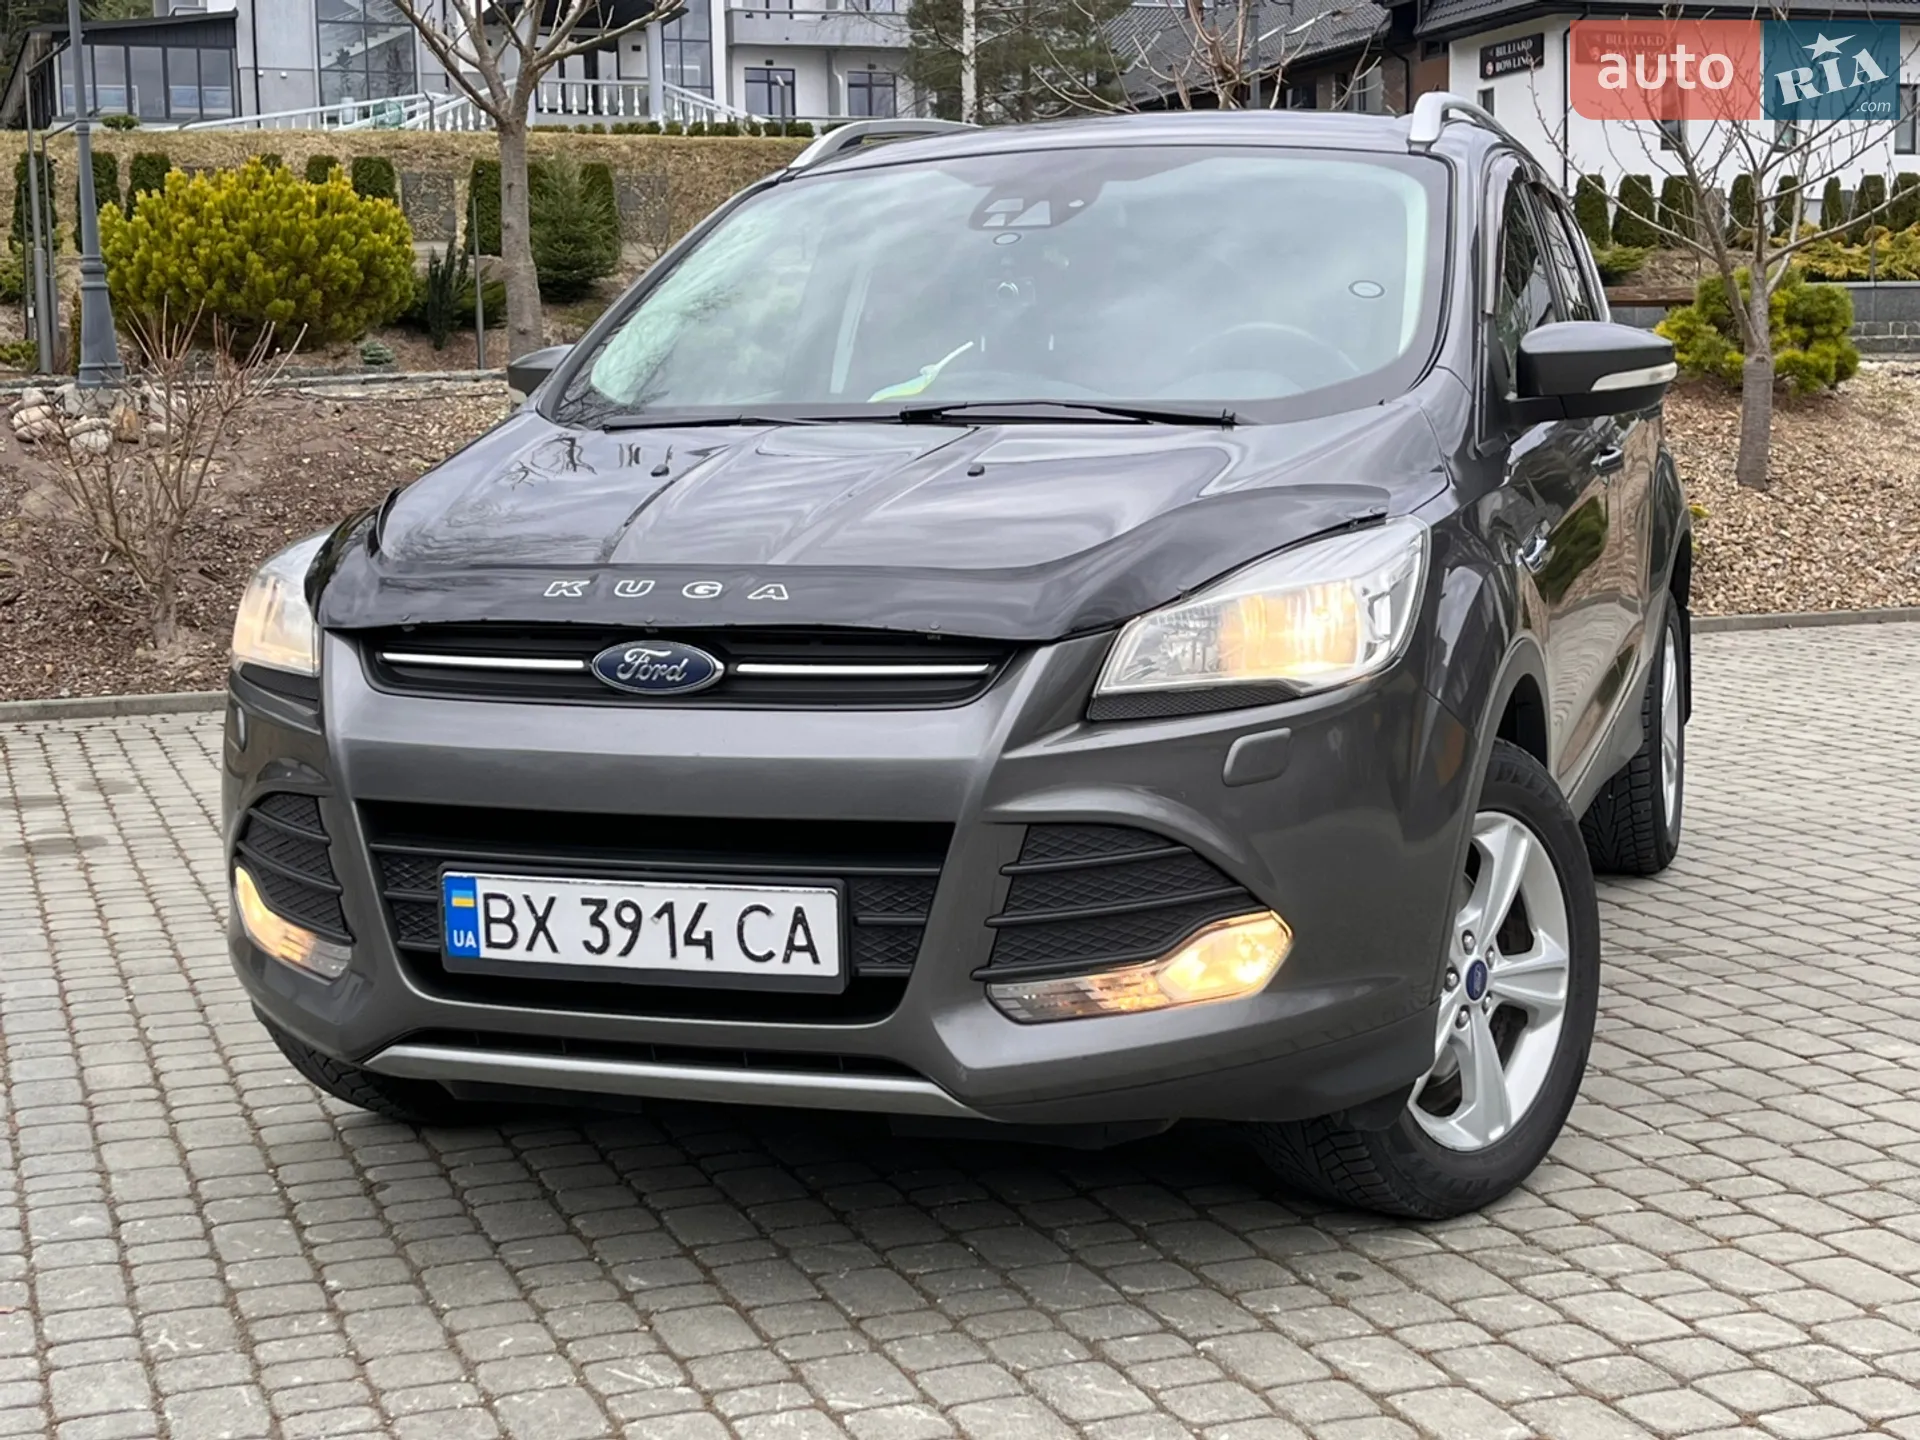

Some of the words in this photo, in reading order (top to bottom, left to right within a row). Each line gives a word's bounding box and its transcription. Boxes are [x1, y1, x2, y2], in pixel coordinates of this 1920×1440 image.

[1495, 39, 1533, 57] BILLIARD
[543, 580, 789, 600] KUGA
[616, 647, 689, 682] Ford
[453, 929, 477, 948] UA
[483, 892, 559, 954] BX
[580, 897, 714, 961] 3914
[736, 903, 821, 965] CA
